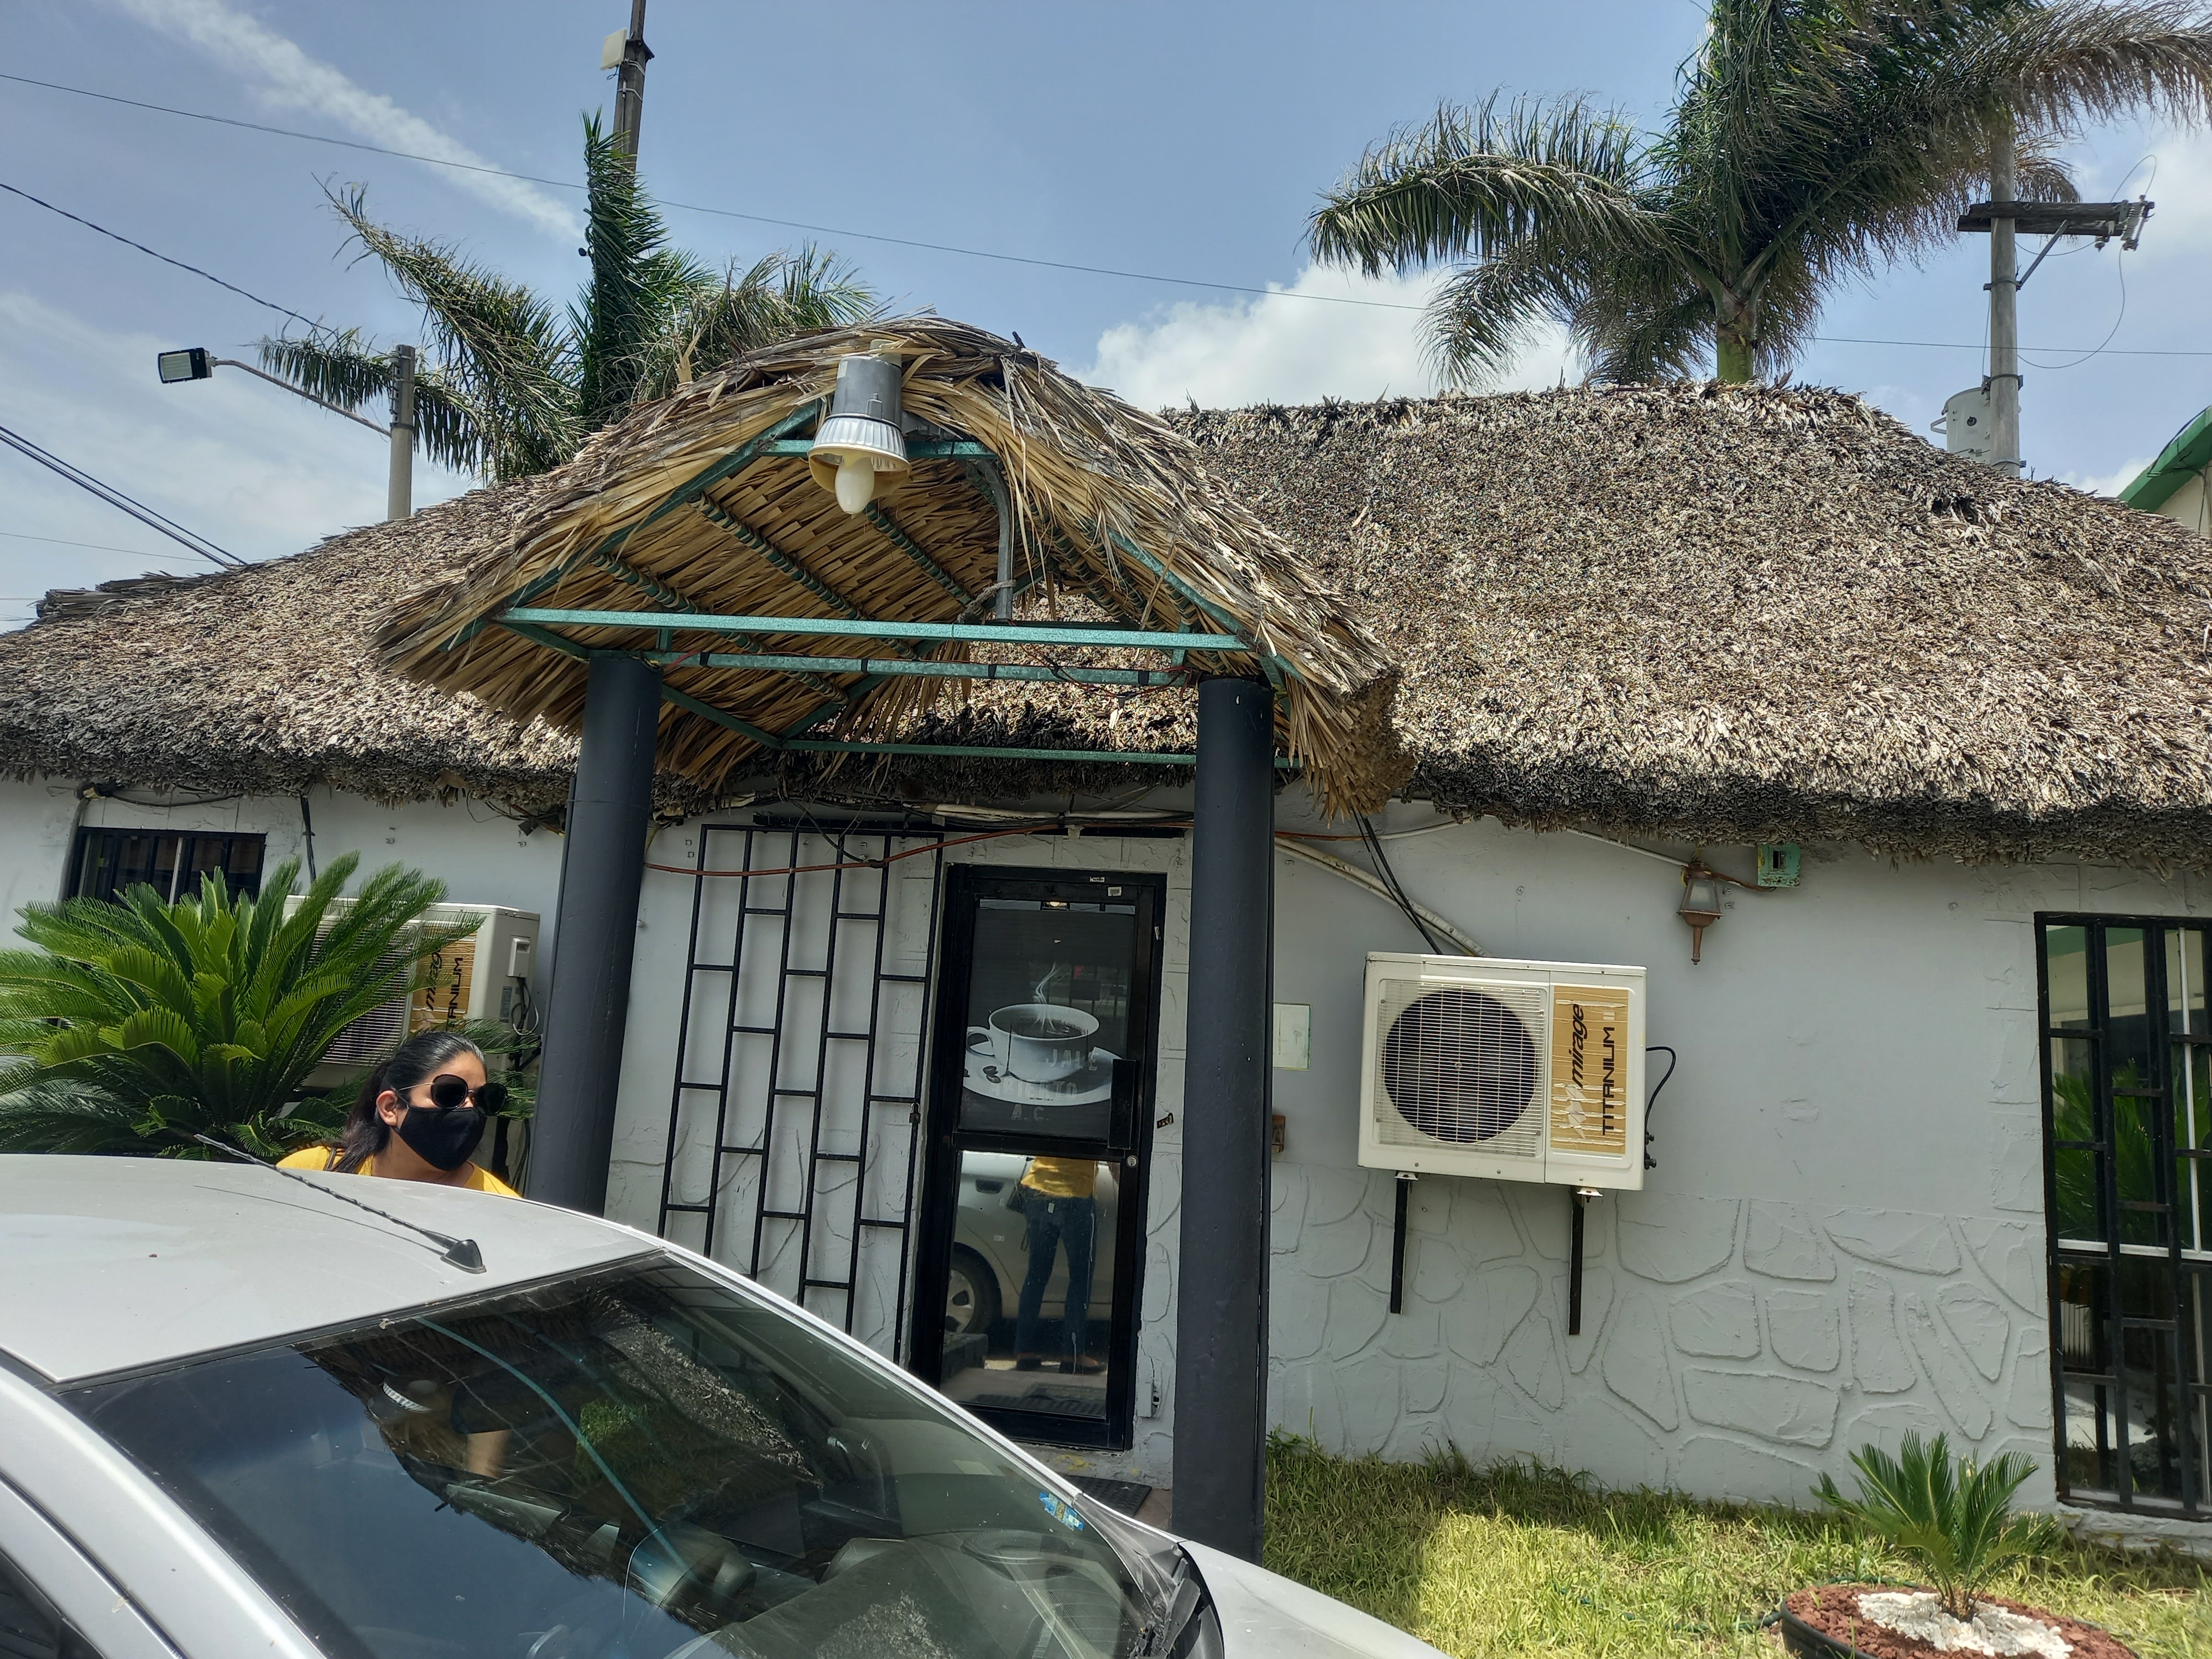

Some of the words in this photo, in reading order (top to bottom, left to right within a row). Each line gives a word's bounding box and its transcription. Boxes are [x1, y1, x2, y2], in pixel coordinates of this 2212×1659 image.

[446, 957, 463, 1032] ANIUM
[1046, 1048, 1098, 1071] JALE
[1569, 1004, 1588, 1088] mirage
[1603, 1027, 1615, 1136] TITANIUM
